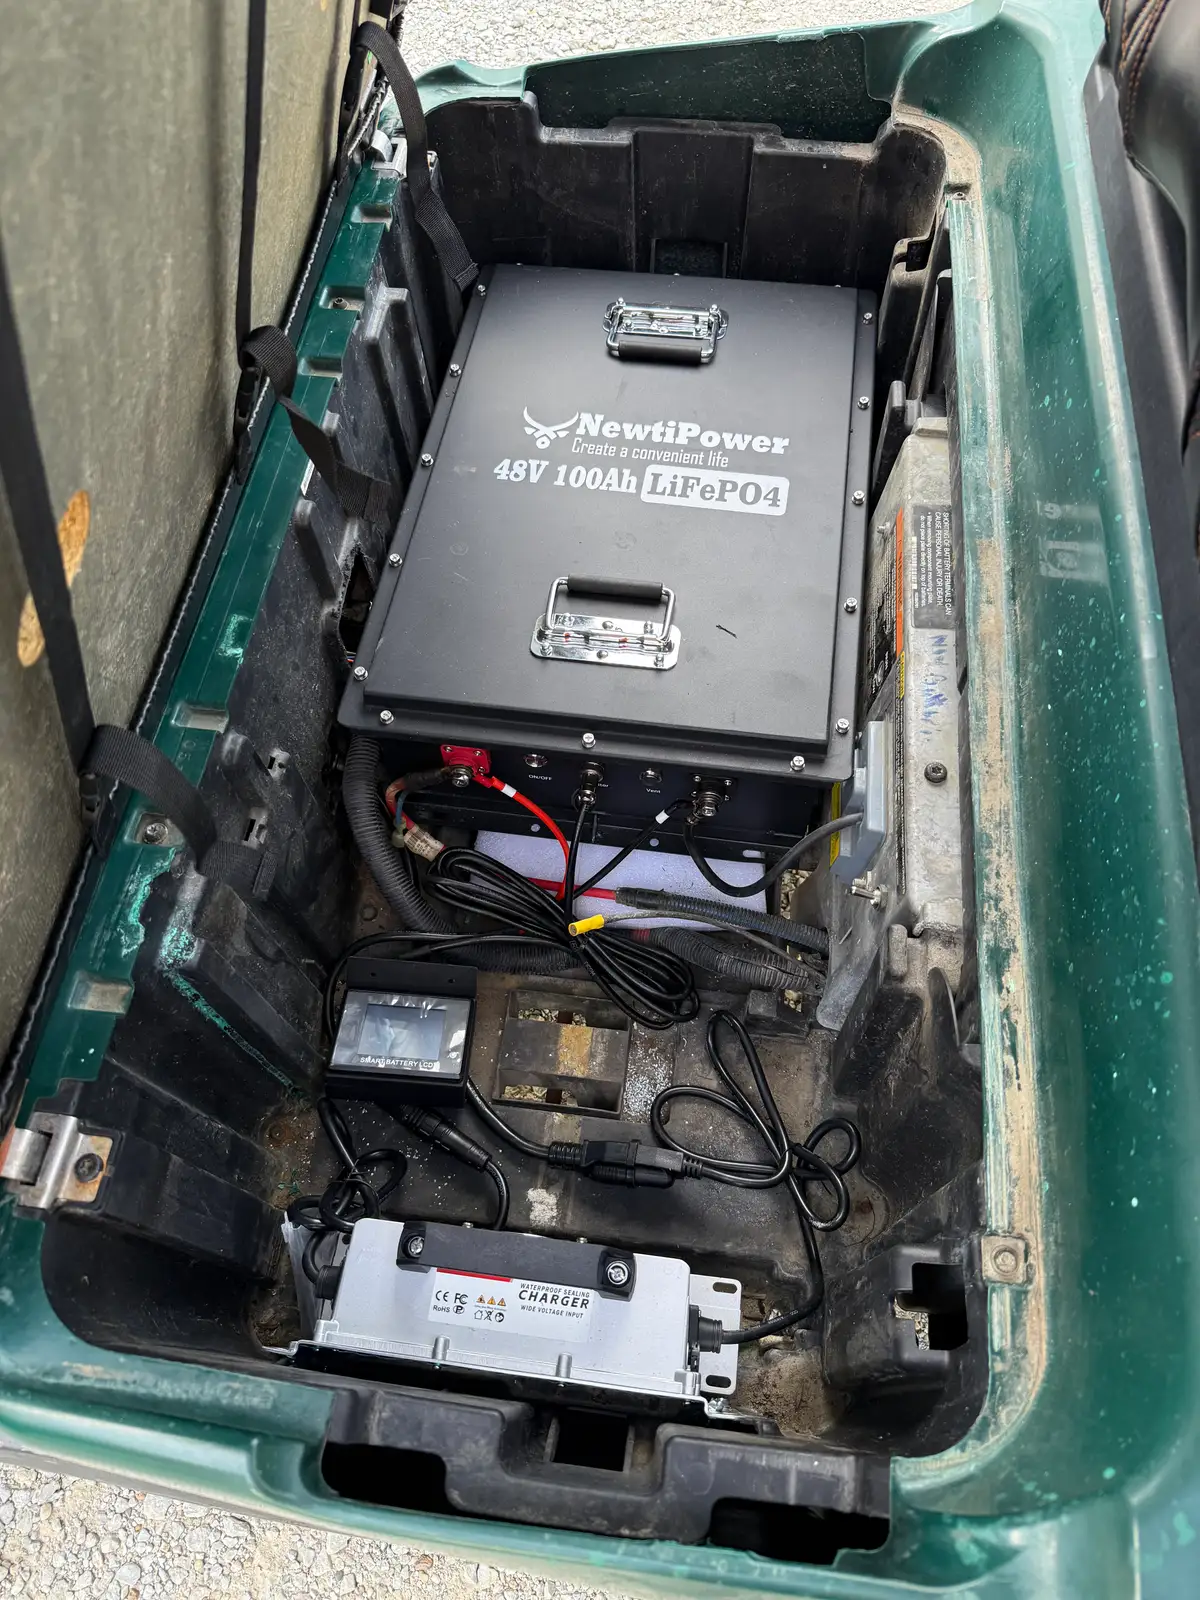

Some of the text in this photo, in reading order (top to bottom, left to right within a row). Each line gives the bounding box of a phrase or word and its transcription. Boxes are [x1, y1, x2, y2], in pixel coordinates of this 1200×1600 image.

[576, 412, 790, 455] NewtiPower
[572, 437, 730, 468] Create a convenient life
[493, 458, 782, 508] 48V 100Ah LiFePO4
[935, 530, 943, 558] PERSONAL
[919, 551, 927, 567] directly
[943, 512, 952, 616] SHORTING OF BATTERY TERMINALS CAN
[936, 578, 943, 587] OR
[360, 1056, 434, 1069] SMART BATTERY LCD
[435, 1290, 450, 1302] CE
[518, 1289, 590, 1309] CHARGER
[520, 1282, 590, 1299] WATERPROOF SEALING
[433, 1305, 450, 1313] RoHS
[520, 1305, 584, 1319] WIDE VOLTAGE INPUT
